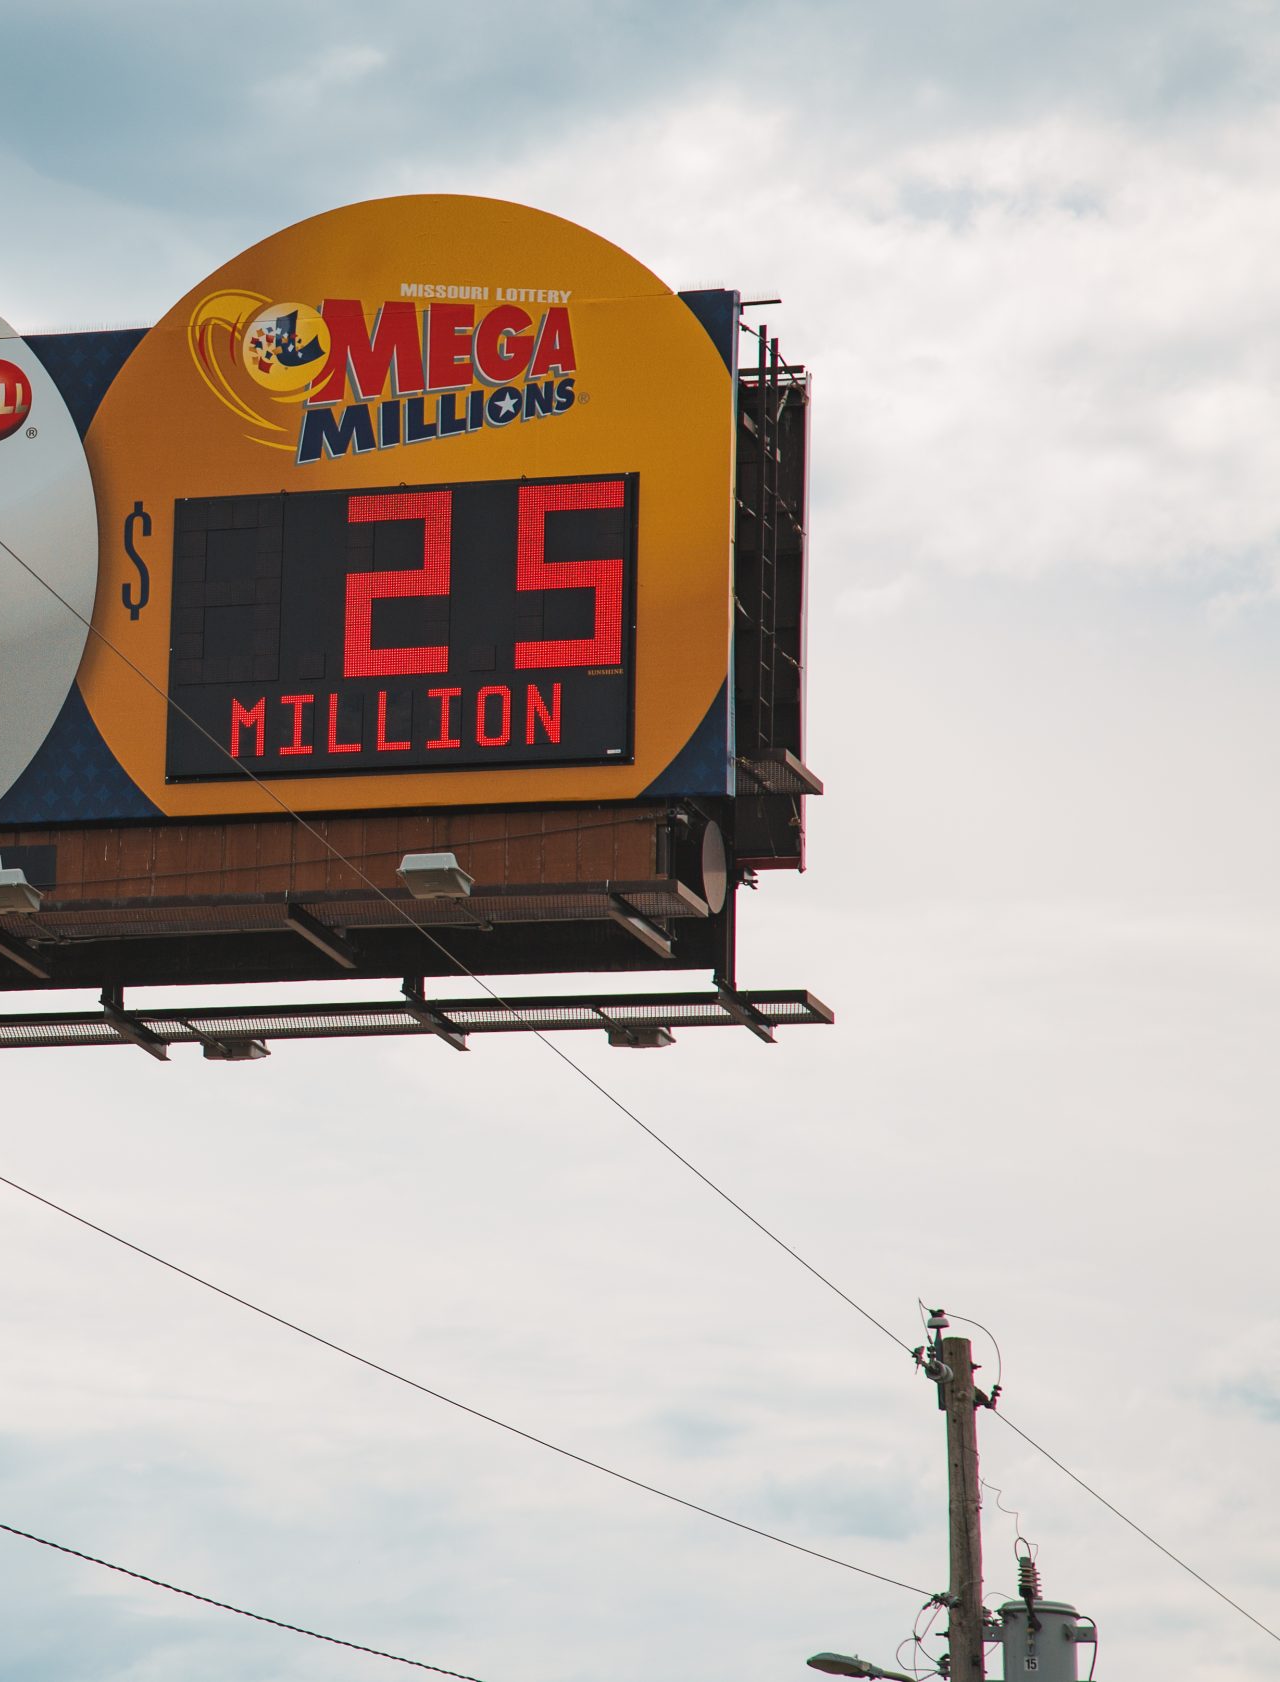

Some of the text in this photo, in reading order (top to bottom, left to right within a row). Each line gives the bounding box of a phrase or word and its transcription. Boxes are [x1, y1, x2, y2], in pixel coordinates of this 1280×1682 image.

[400, 282, 572, 304] MISSOURI LOTTERY
[303, 298, 577, 410] MEGA
[294, 377, 577, 465] MILLIONS
[343, 481, 626, 677] 25
[231, 683, 562, 758] MILLION
[1025, 1658, 1037, 1670] 15
